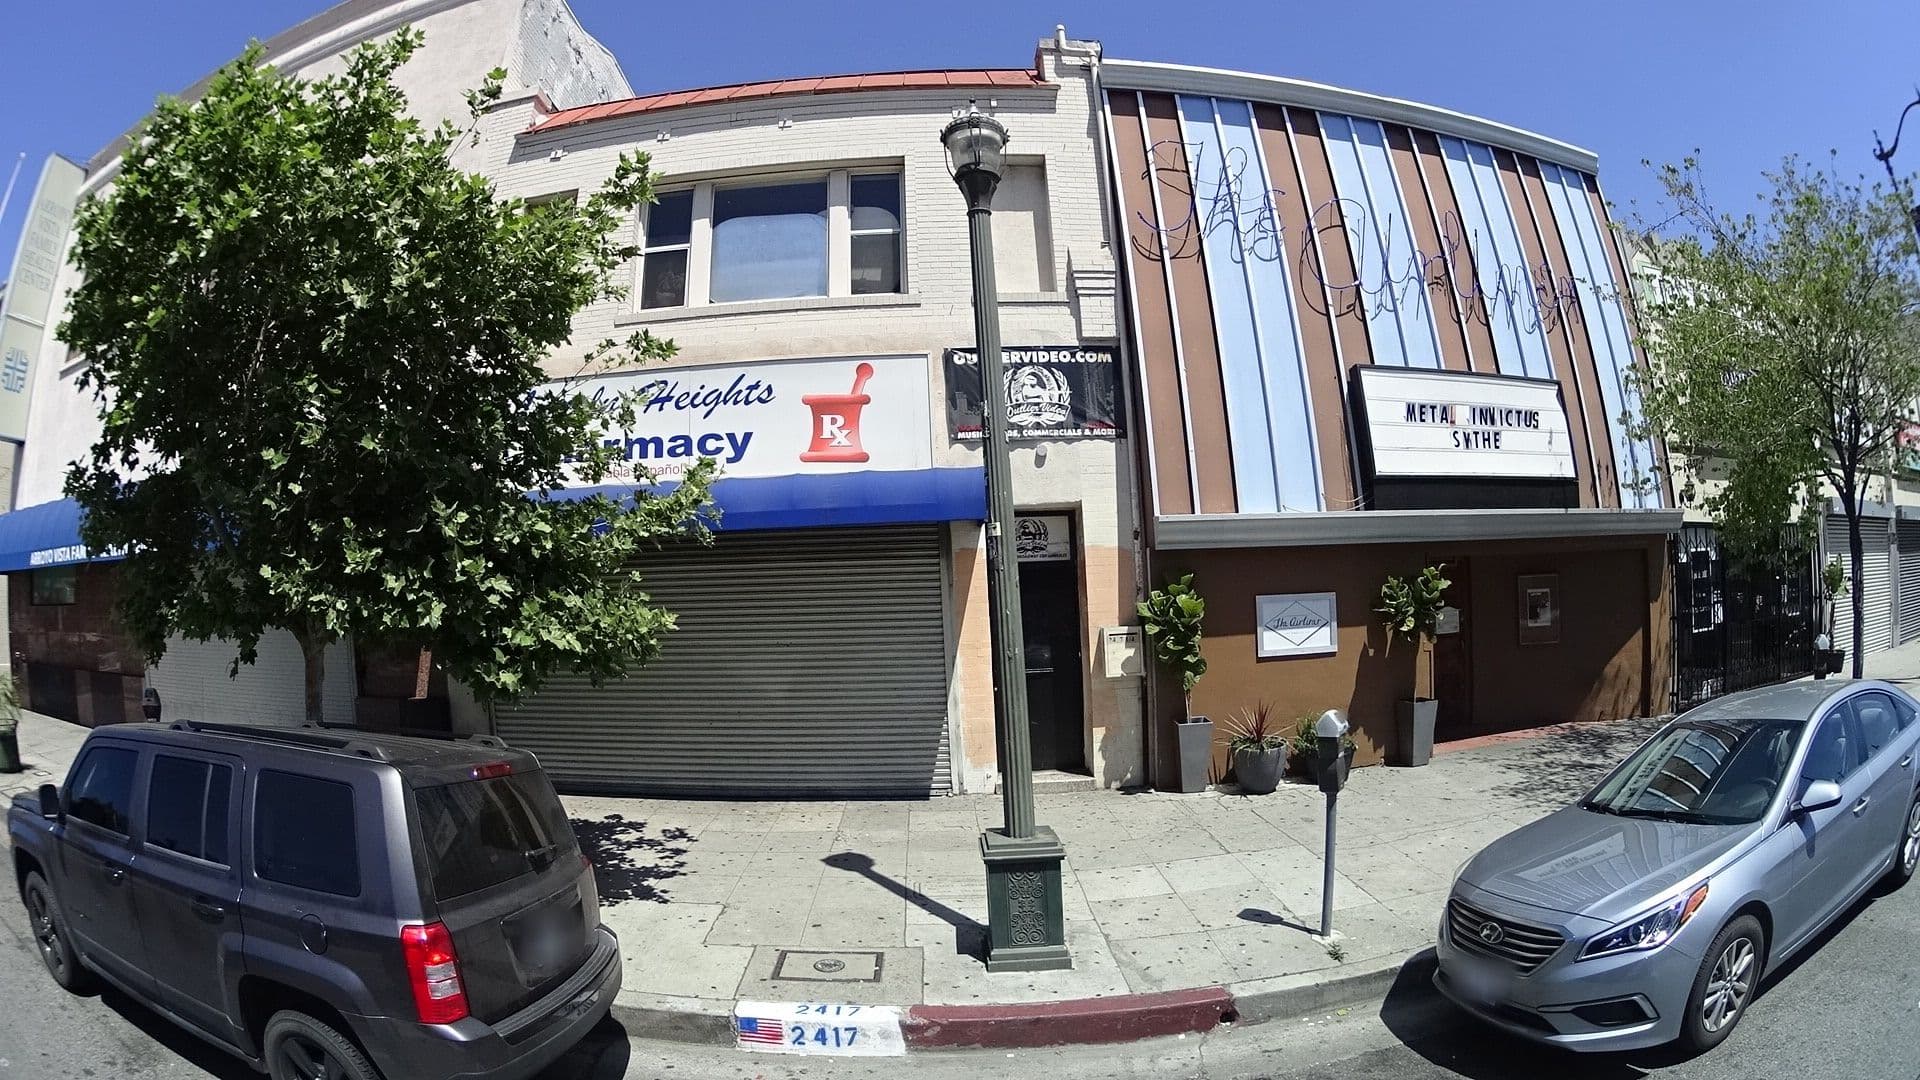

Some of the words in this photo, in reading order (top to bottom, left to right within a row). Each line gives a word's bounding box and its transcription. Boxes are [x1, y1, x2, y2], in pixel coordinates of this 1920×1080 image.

[953, 351, 1112, 364] OUERVIDEO.COM
[639, 373, 776, 419] Heights
[1406, 403, 1456, 425] METAL
[1472, 406, 1539, 429] INVICTUS
[958, 431, 983, 439] MUSI
[1023, 429, 1082, 437] COMMERCIALS
[566, 431, 753, 464] rmacy
[1273, 618, 1288, 629] The
[1290, 616, 1321, 627] Airliner
[795, 1005, 861, 1016] 2417
[790, 1025, 859, 1047] 2417
